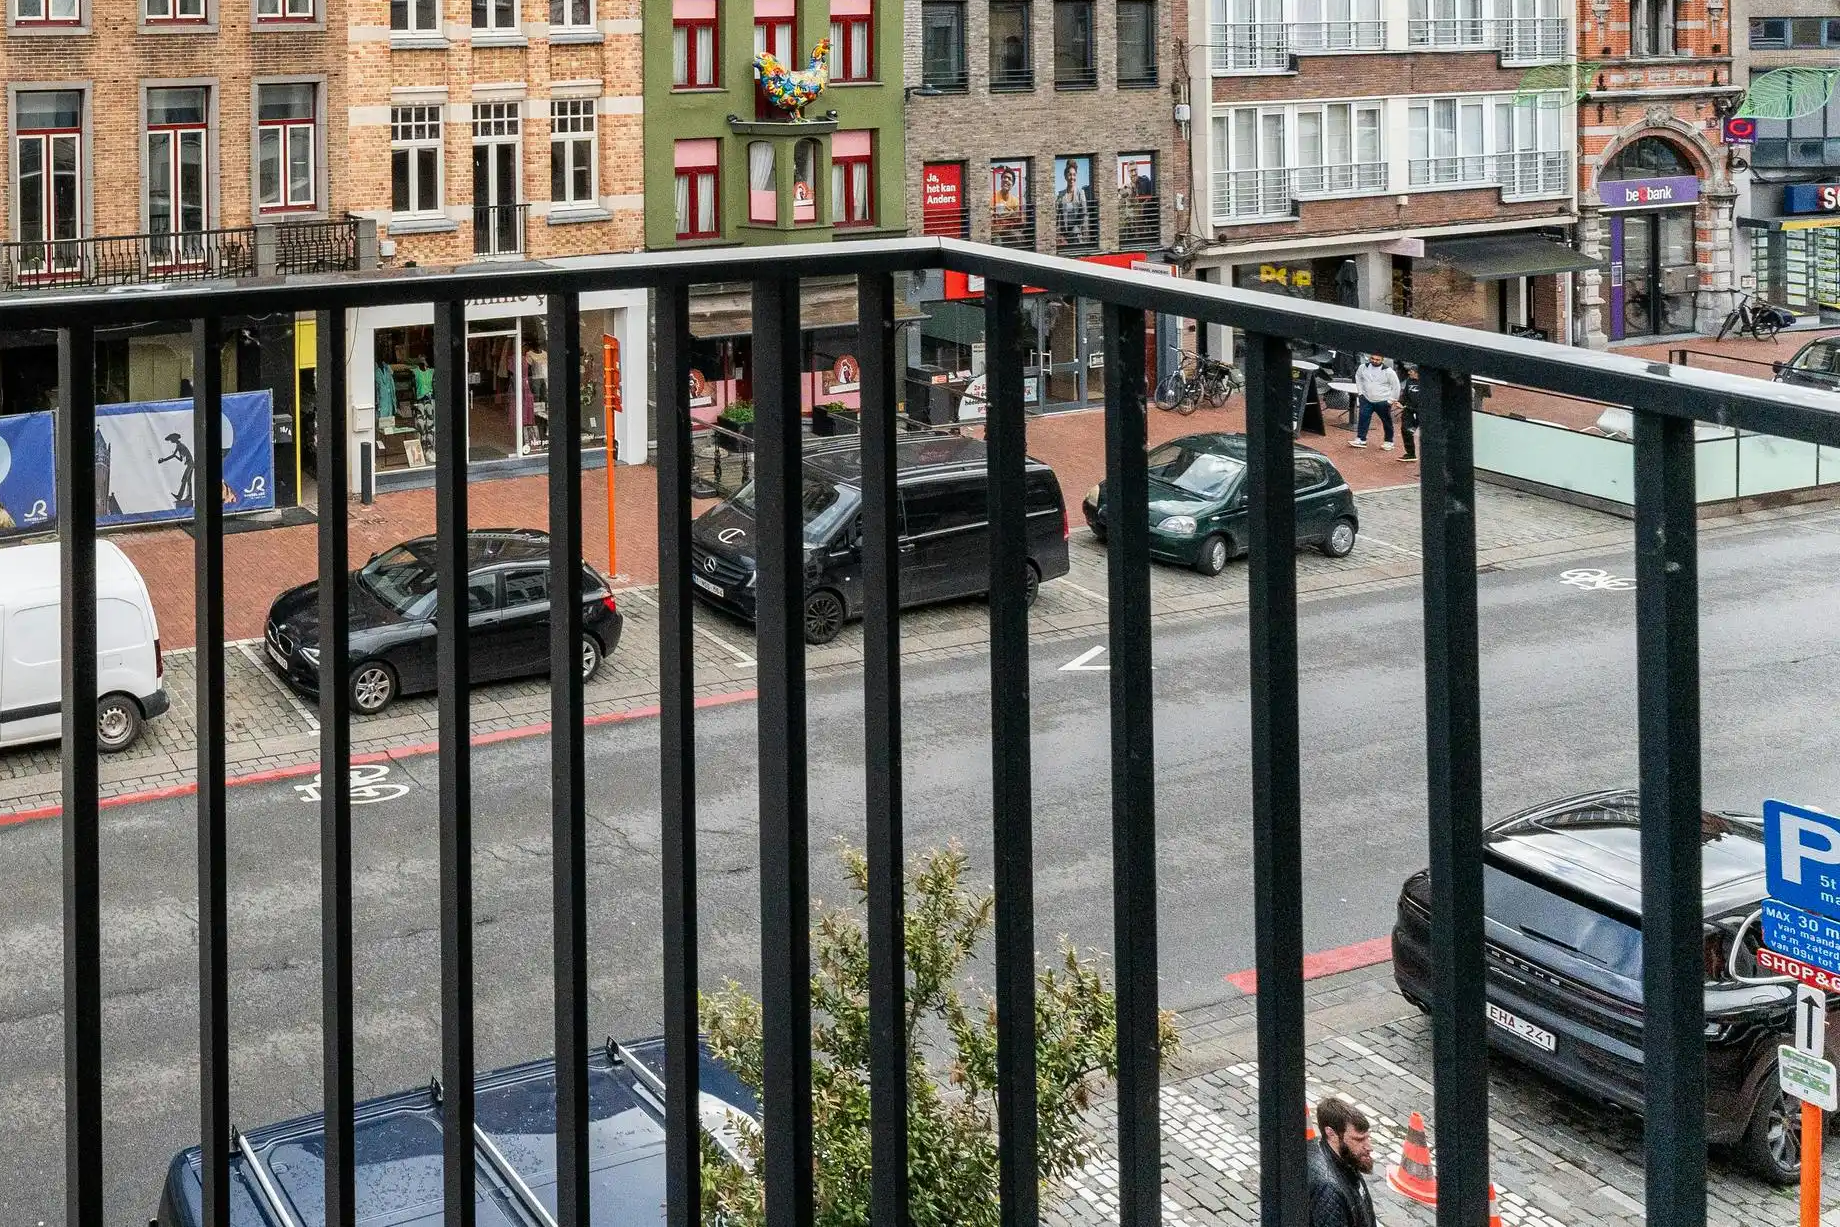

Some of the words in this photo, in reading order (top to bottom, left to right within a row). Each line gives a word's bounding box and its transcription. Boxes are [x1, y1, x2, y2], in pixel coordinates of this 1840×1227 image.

[926, 173, 939, 183] Ja,
[926, 184, 940, 193] het
[941, 183, 956, 192] kan
[927, 194, 956, 204] Anders
[1779, 811, 1840, 885] P
[1820, 875, 1836, 890] 5t
[1777, 922, 1796, 934] van
[1798, 915, 1819, 932] 30
[1771, 940, 1789, 952] van
[1792, 947, 1814, 961] 09u
[1818, 956, 1833, 968] tot
